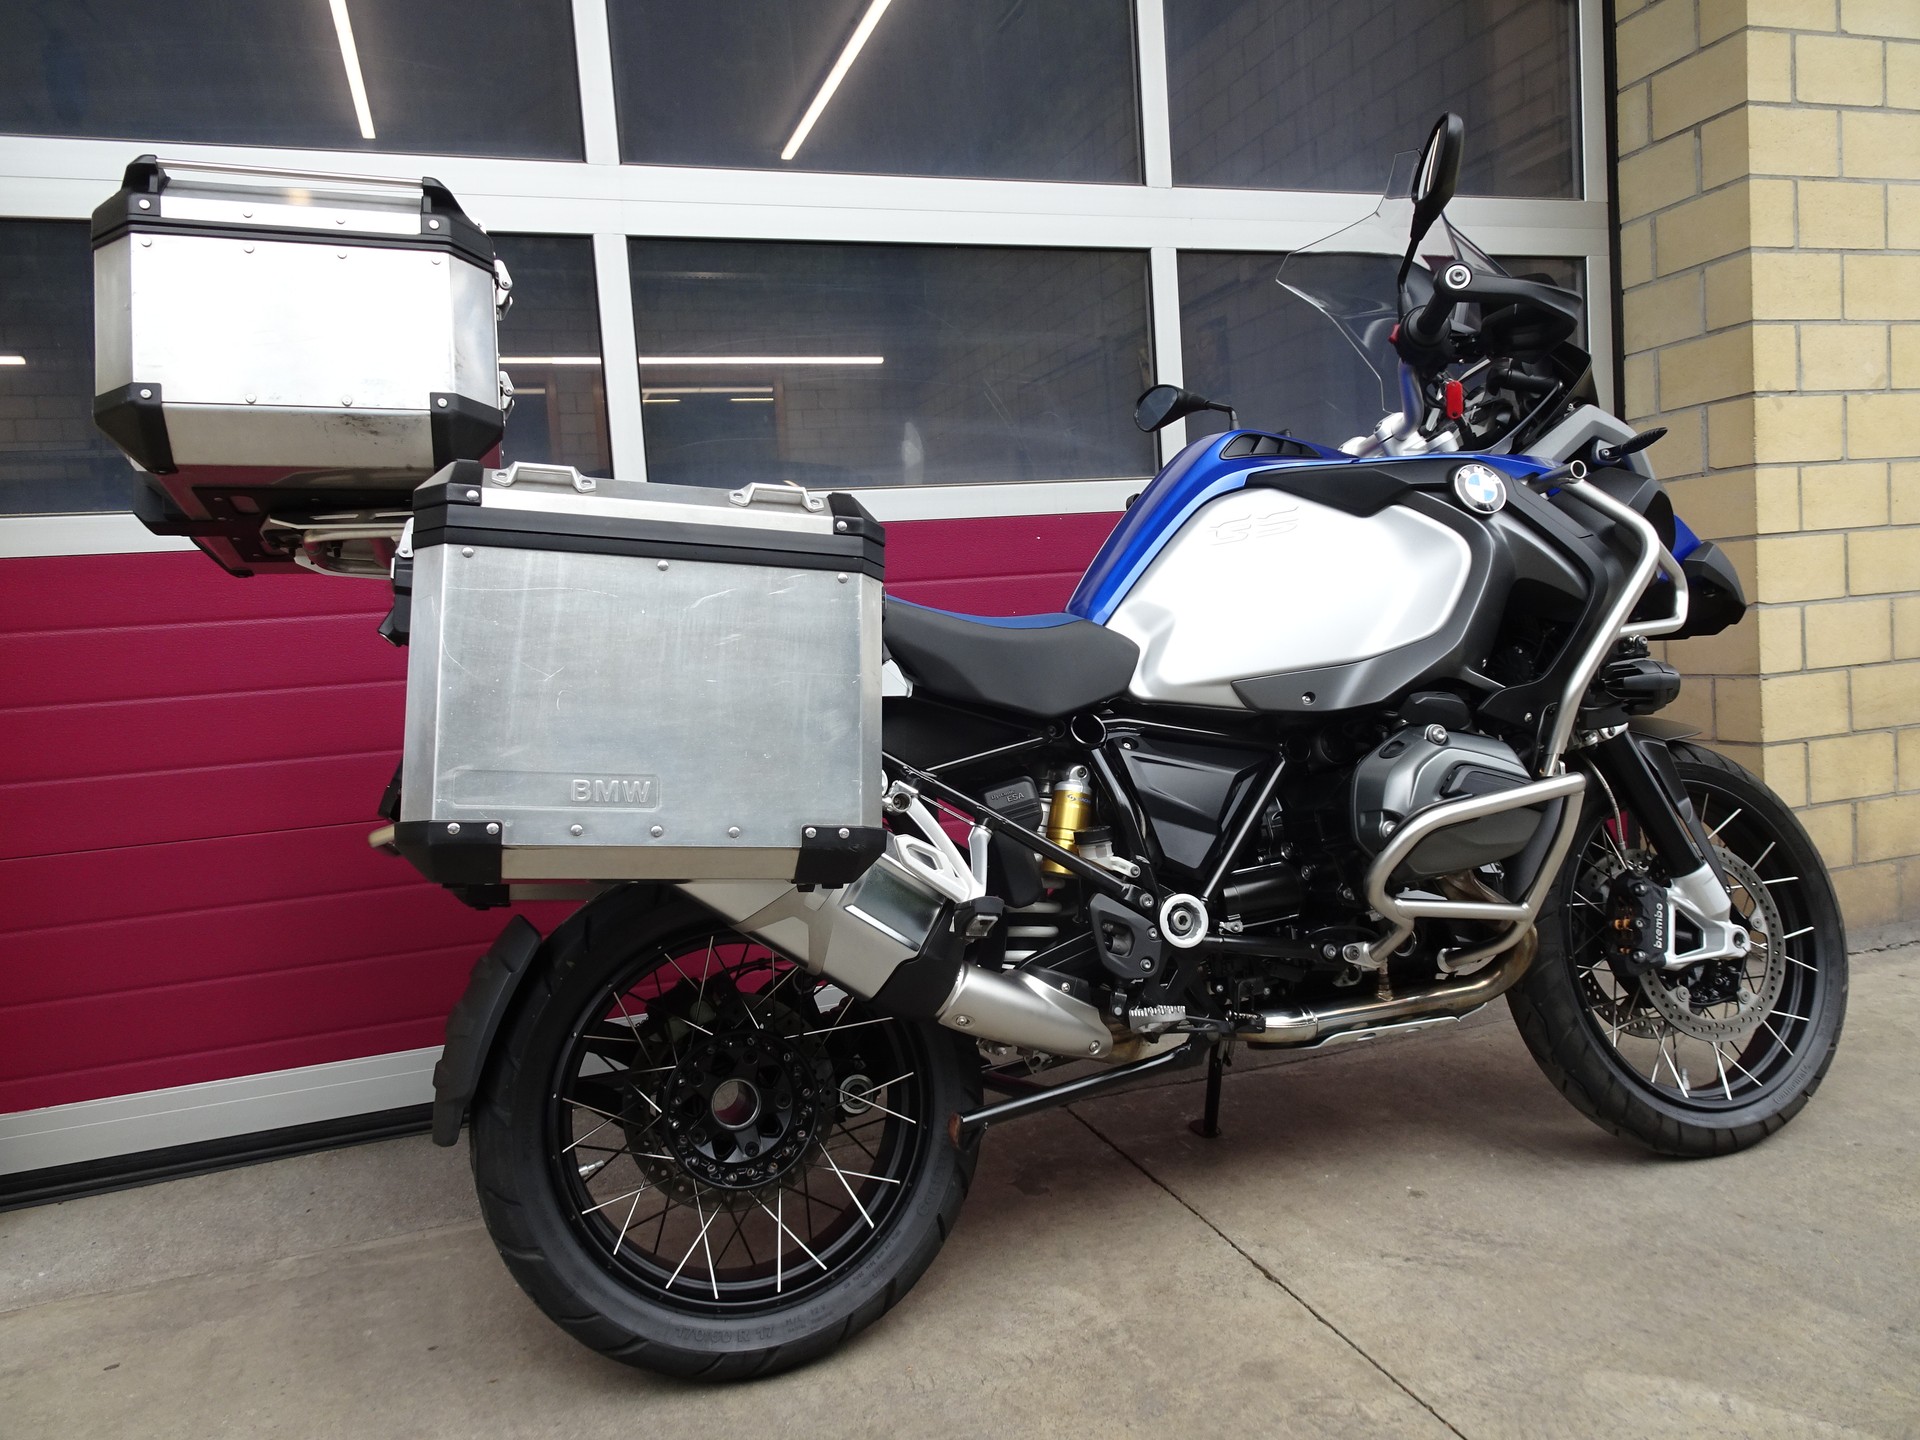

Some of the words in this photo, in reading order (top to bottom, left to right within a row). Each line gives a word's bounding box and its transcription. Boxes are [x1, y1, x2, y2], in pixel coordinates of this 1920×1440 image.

[1209, 504, 1301, 547] GS
[571, 778, 651, 803] BMW
[1006, 792, 1025, 803] ESA
[1653, 902, 1665, 950] brembo
[755, 1325, 776, 1341] 17
